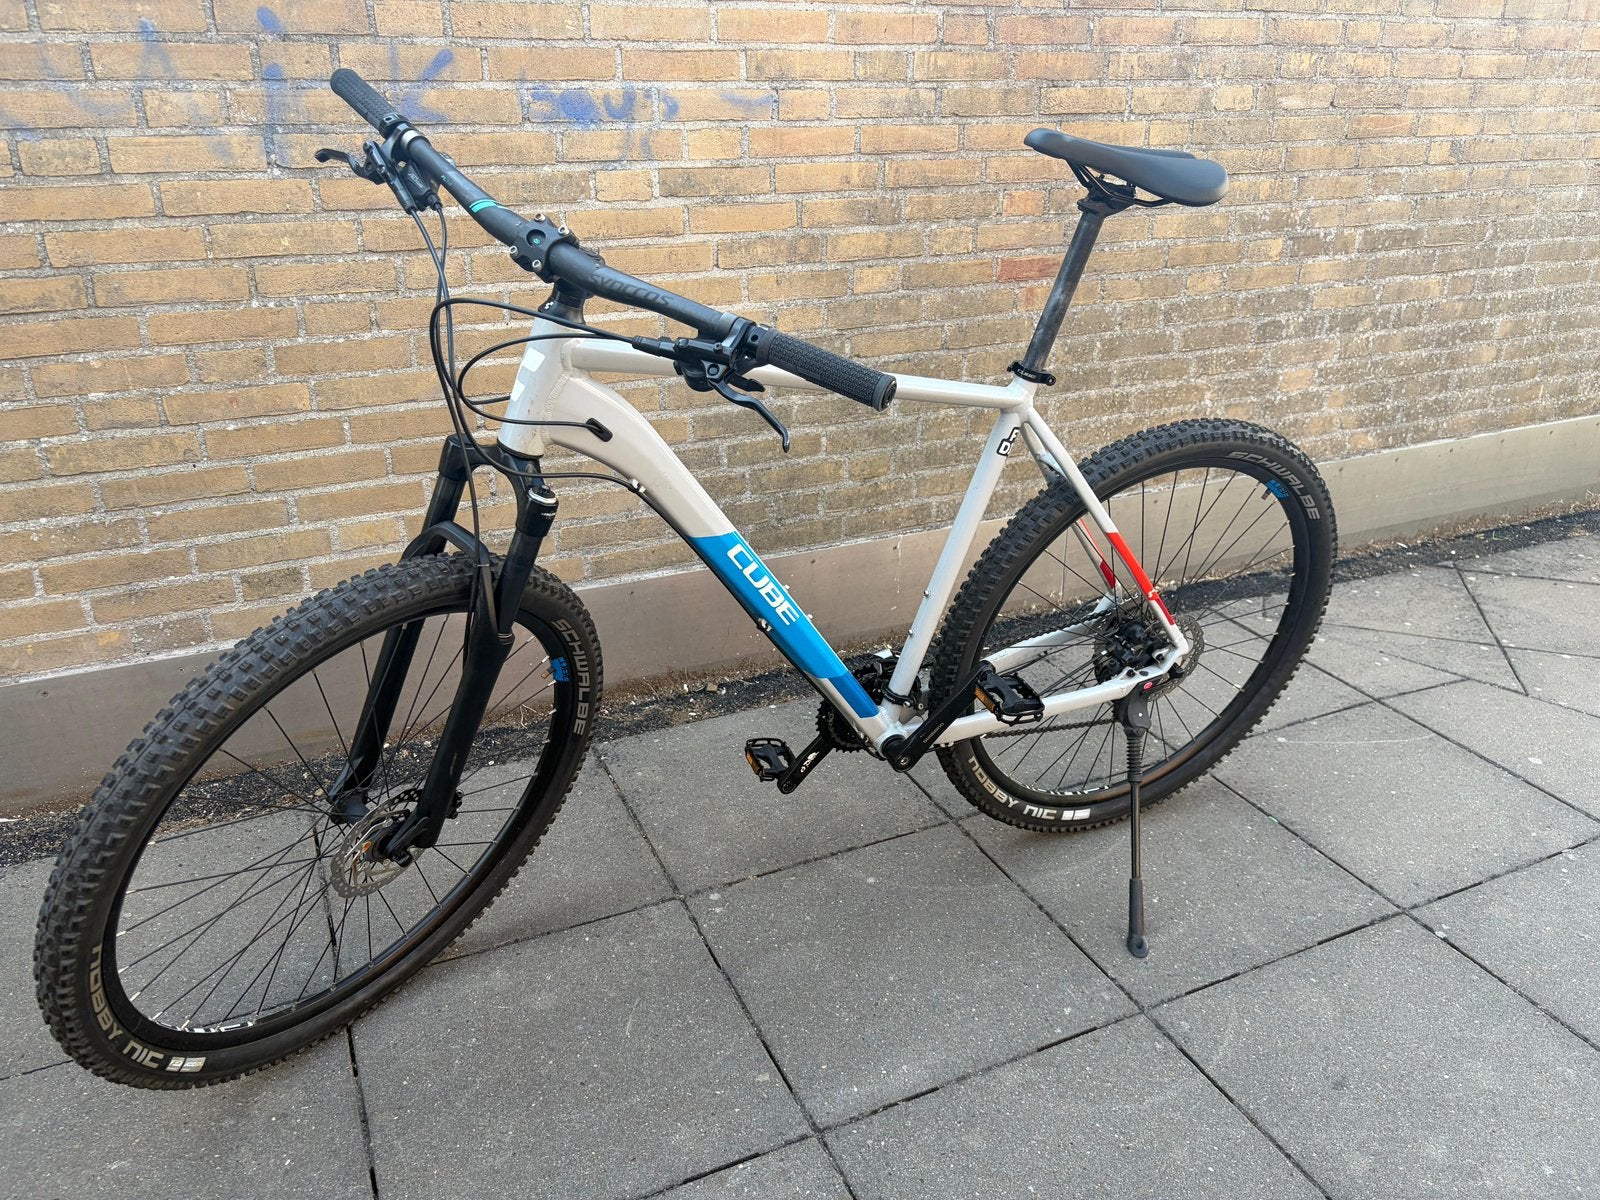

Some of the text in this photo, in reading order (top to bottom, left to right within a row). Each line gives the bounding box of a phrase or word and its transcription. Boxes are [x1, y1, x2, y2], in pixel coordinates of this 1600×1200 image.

[1227, 451, 1321, 520] SCHWALBE
[726, 543, 800, 626] CUBE
[552, 618, 591, 735] SCHWALBE
[967, 755, 1019, 808] NOBBY
[1022, 804, 1057, 820] NIC
[122, 1040, 165, 1069] NIC
